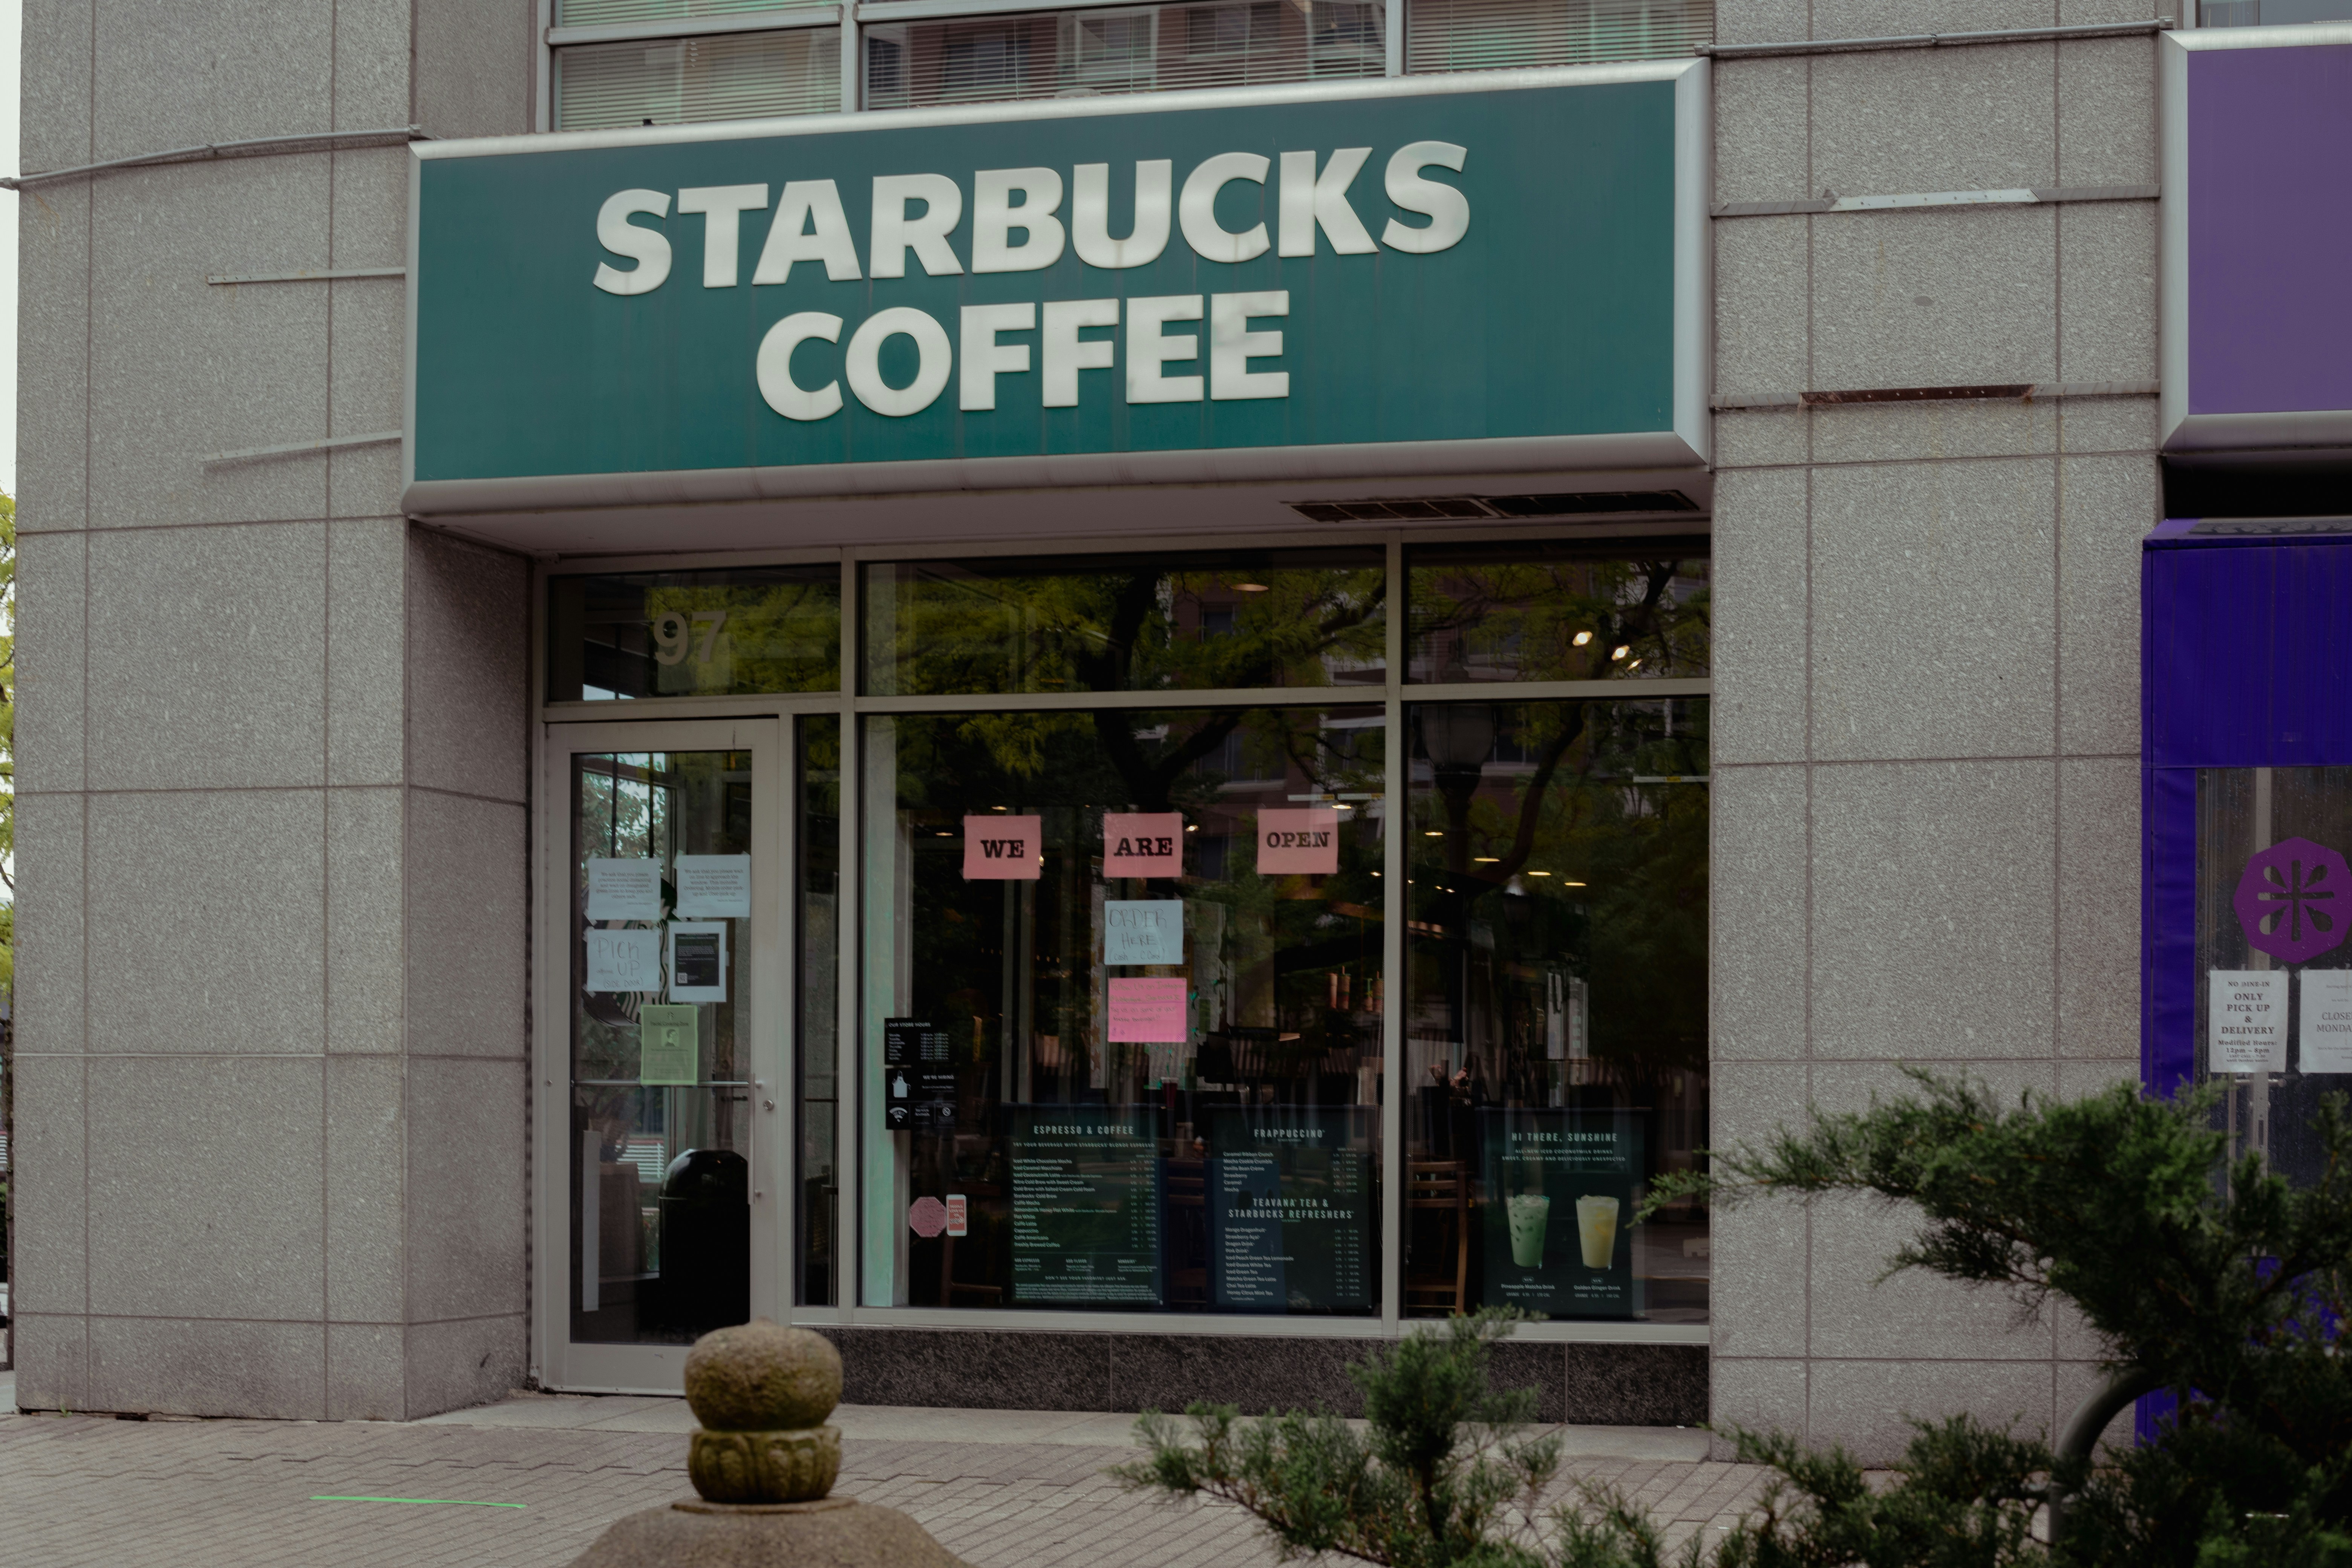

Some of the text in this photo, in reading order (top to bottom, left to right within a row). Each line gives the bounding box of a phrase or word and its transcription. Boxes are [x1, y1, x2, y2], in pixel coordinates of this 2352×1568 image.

[594, 139, 1472, 297] STARBUCKS
[754, 287, 1291, 424] COFFEE
[653, 611, 727, 666] 97
[981, 831, 1329, 859] WE ARE OPEN
[1109, 908, 1167, 929] ORDER
[593, 937, 639, 960] PICK
[1121, 931, 1157, 950] HERE
[617, 959, 640, 977] UP
[2317, 1024, 2352, 1032] MONDA
[1034, 1125, 1134, 1135] ESPRESSO & COFFEE
[1254, 1129, 1323, 1138] FRAPPUCCINO
[1512, 1133, 1617, 1142] HI THERE, SUNSHINE
[1300, 1198, 1317, 1207] TEA
[1323, 1198, 1329, 1207] &
[1228, 1209, 1283, 1218] STARBUCKS
